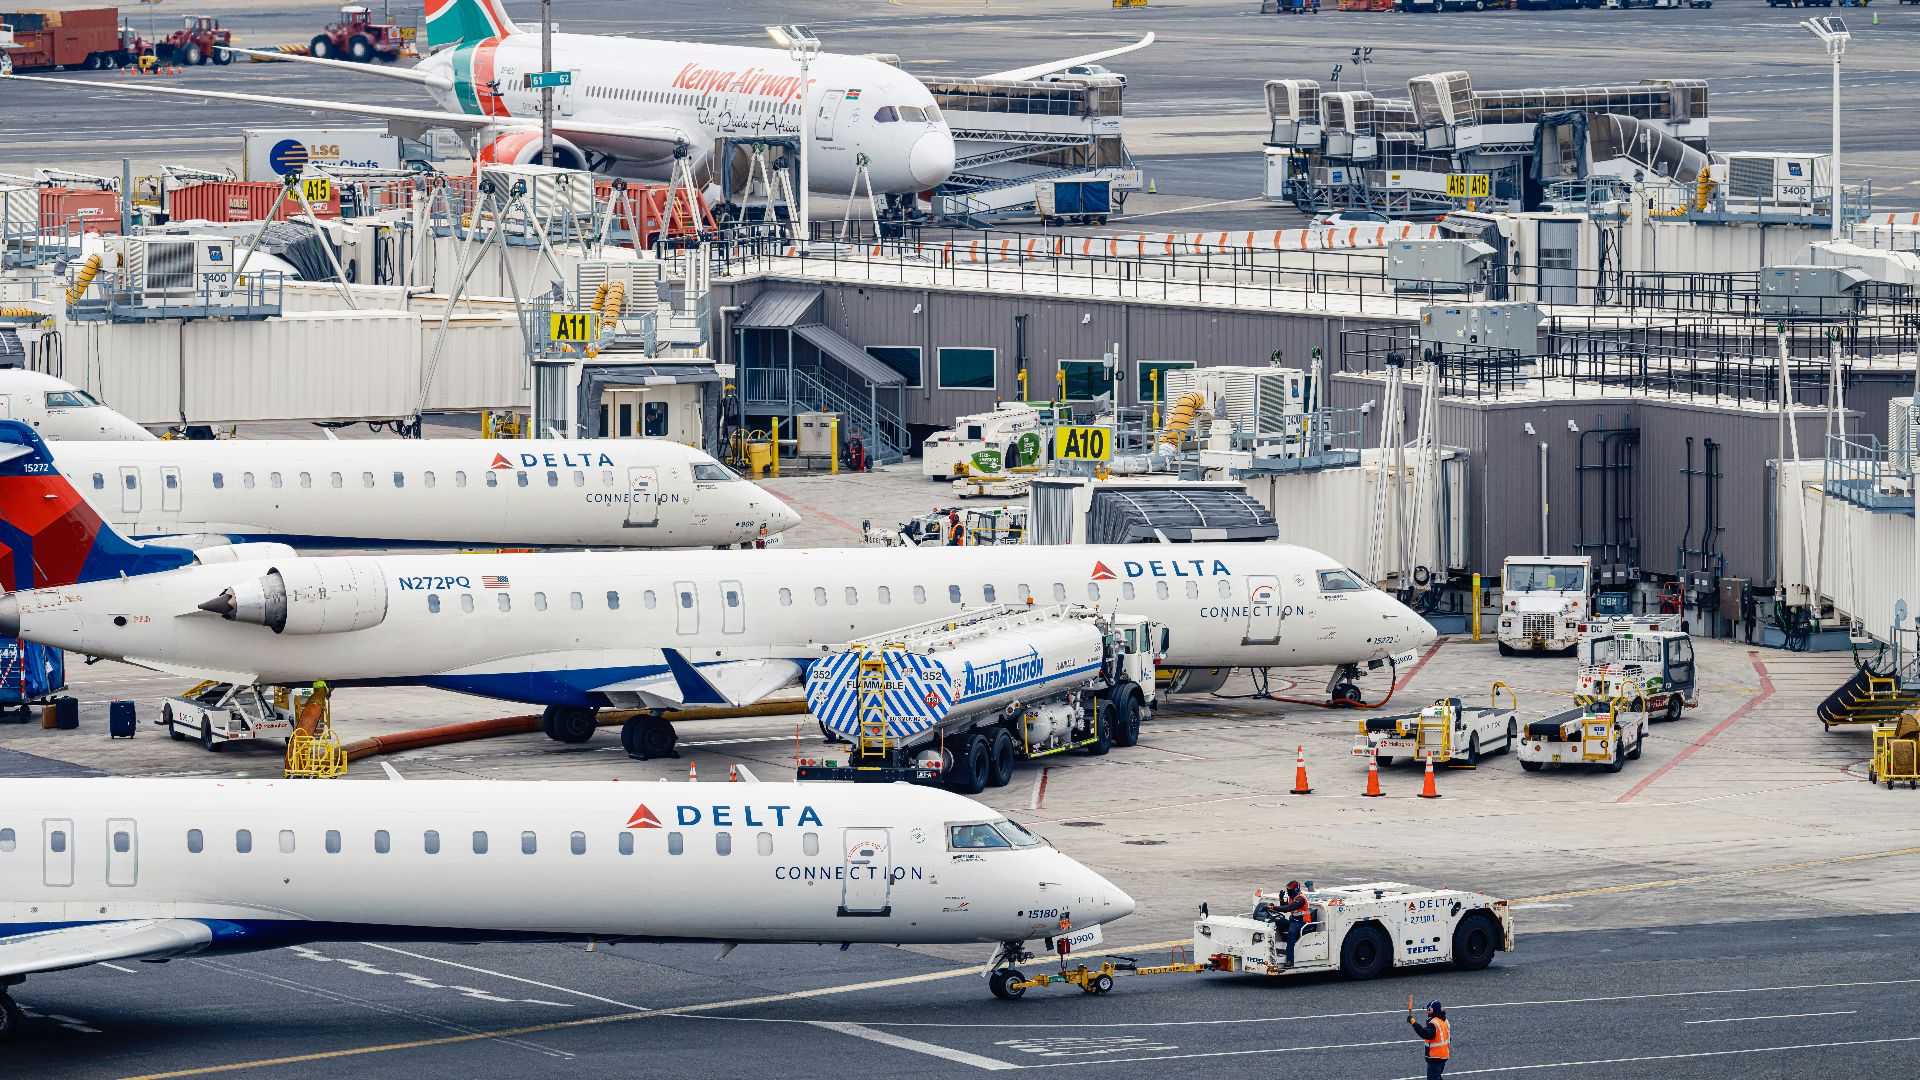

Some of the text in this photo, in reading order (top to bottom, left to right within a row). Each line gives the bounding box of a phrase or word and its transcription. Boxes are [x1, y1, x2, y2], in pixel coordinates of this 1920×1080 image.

[533, 74, 570, 85] 61 62
[672, 63, 737, 97] Kenya
[697, 107, 714, 125] The
[717, 111, 748, 132] Pride
[750, 114, 761, 134] of
[311, 144, 340, 156] LSG
[306, 179, 327, 201] A15
[1449, 177, 1465, 195] A16
[1471, 177, 1486, 194] A16
[1782, 186, 1806, 195] 3400
[556, 314, 586, 341] A11
[1063, 428, 1104, 459] A10
[520, 452, 615, 468] DELTA
[23, 463, 49, 473] 15272
[585, 492, 680, 503] CONNECTION
[1123, 559, 1232, 578] DELTA
[398, 575, 471, 591] N272PQ
[1199, 605, 1306, 618] CONNECTION
[1591, 625, 1603, 633] DC
[813, 670, 831, 680] 352
[922, 671, 942, 681] 352
[846, 680, 904, 690] FLMMABLE
[676, 805, 823, 827] DELTA
[775, 865, 923, 881] CONNECTION
[1419, 897, 1454, 909] DELTA
[1028, 908, 1058, 919] 15180
[1406, 944, 1439, 955] TREPEL
